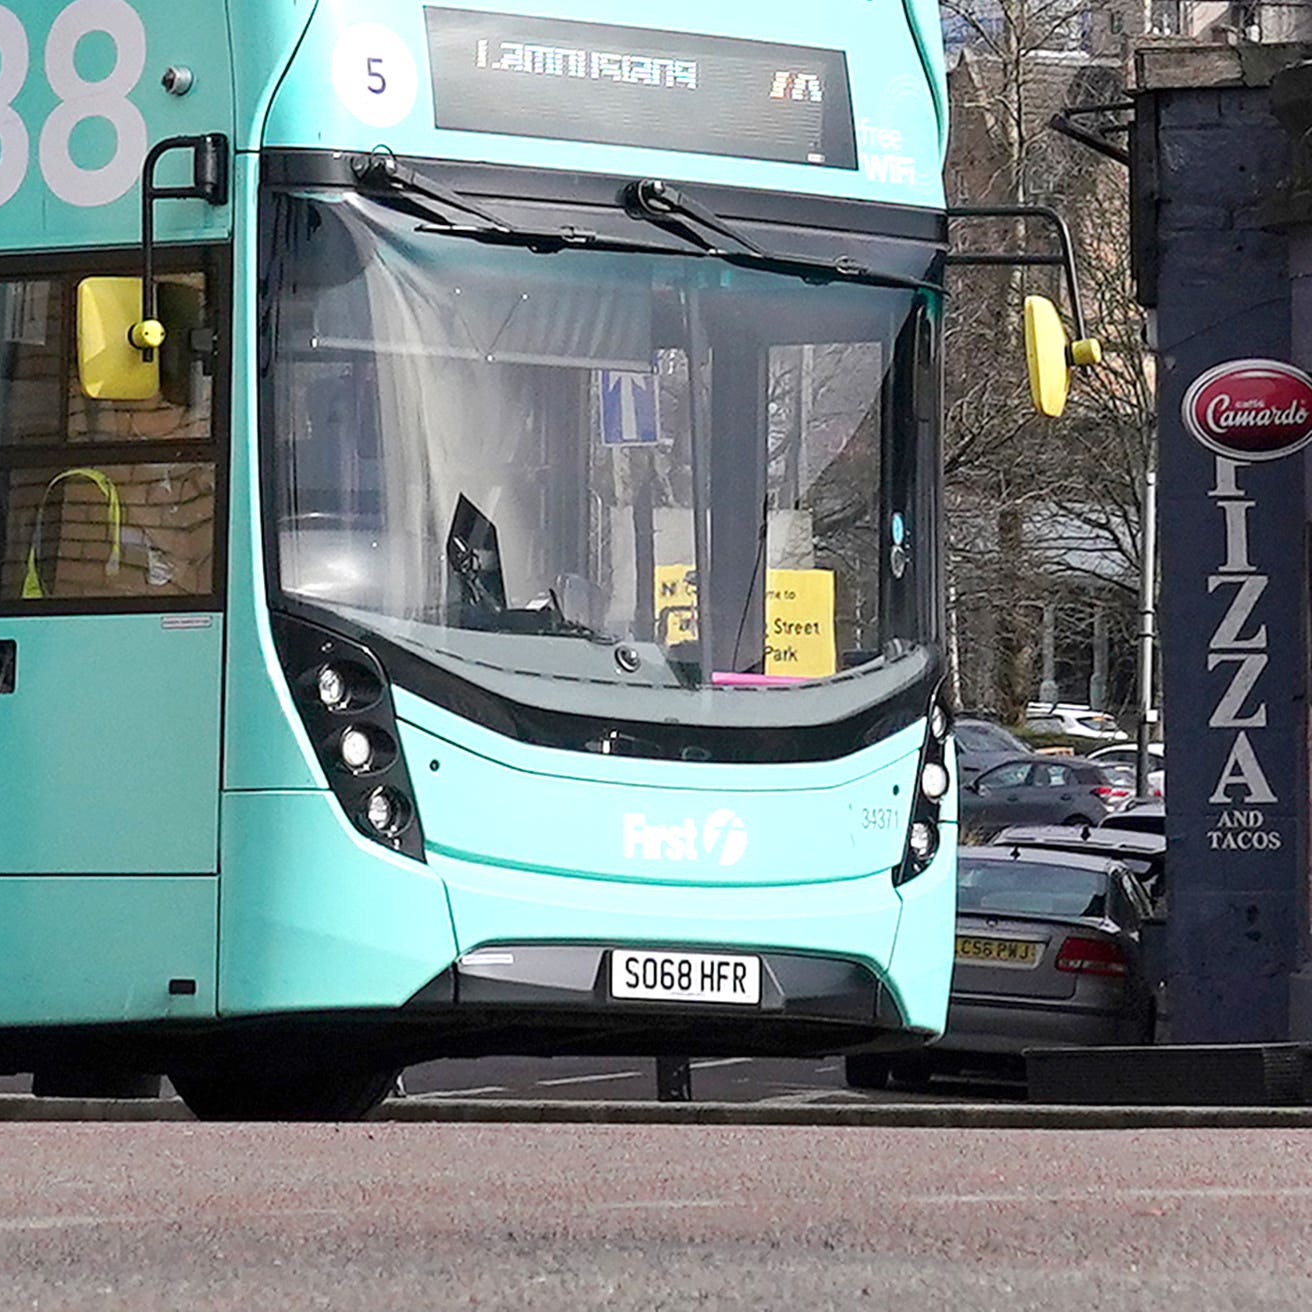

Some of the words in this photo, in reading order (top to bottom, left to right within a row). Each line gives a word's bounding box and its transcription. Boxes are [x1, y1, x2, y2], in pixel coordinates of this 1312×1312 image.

[365, 57, 388, 94] 5
[860, 117, 903, 150] free
[1205, 393, 1309, 434] Camardo
[773, 617, 820, 635] Street
[861, 807, 900, 830] 34371
[1218, 810, 1264, 828] AND
[623, 811, 699, 861] First
[1207, 830, 1282, 850] TACOS
[955, 938, 993, 959] C56
[625, 956, 693, 991] SO68
[700, 960, 747, 995] HFR
